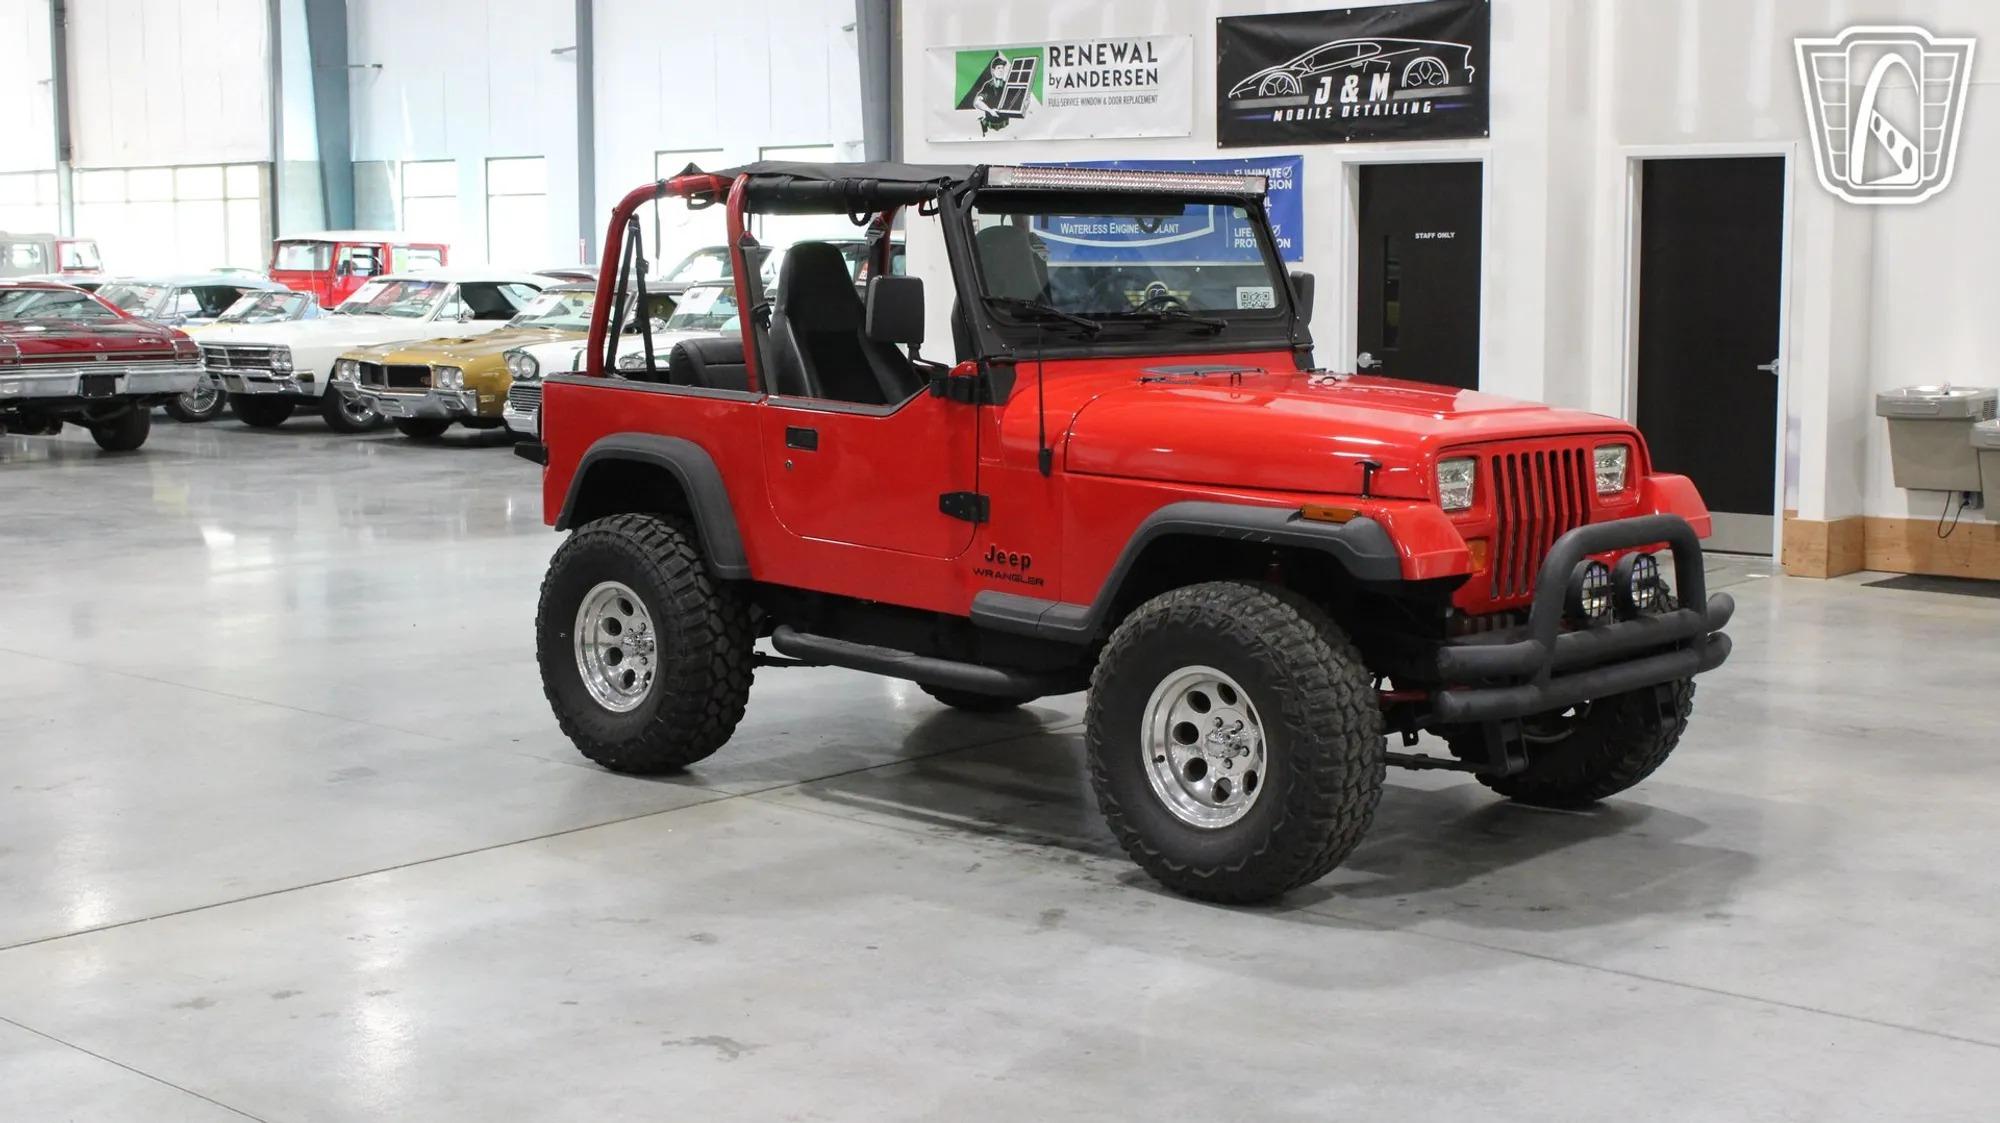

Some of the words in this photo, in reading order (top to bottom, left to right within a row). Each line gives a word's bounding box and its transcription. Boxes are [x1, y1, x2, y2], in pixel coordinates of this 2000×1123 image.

[1049, 41, 1158, 68] RENEWAL
[1048, 73, 1062, 89] by
[1063, 68, 1158, 89] ANDERSEN
[1314, 76, 1332, 105] J
[1340, 75, 1359, 104] &
[1369, 72, 1391, 102] M
[1080, 96, 1102, 107] WINDOW
[1108, 95, 1122, 105] DOOR
[1123, 94, 1158, 104] REPLACEMENT
[1273, 107, 1333, 122] MOBILE
[1341, 101, 1432, 118] DETAILING
[985, 544, 1031, 571] Jeep
[973, 567, 1045, 587] WRANGLER
